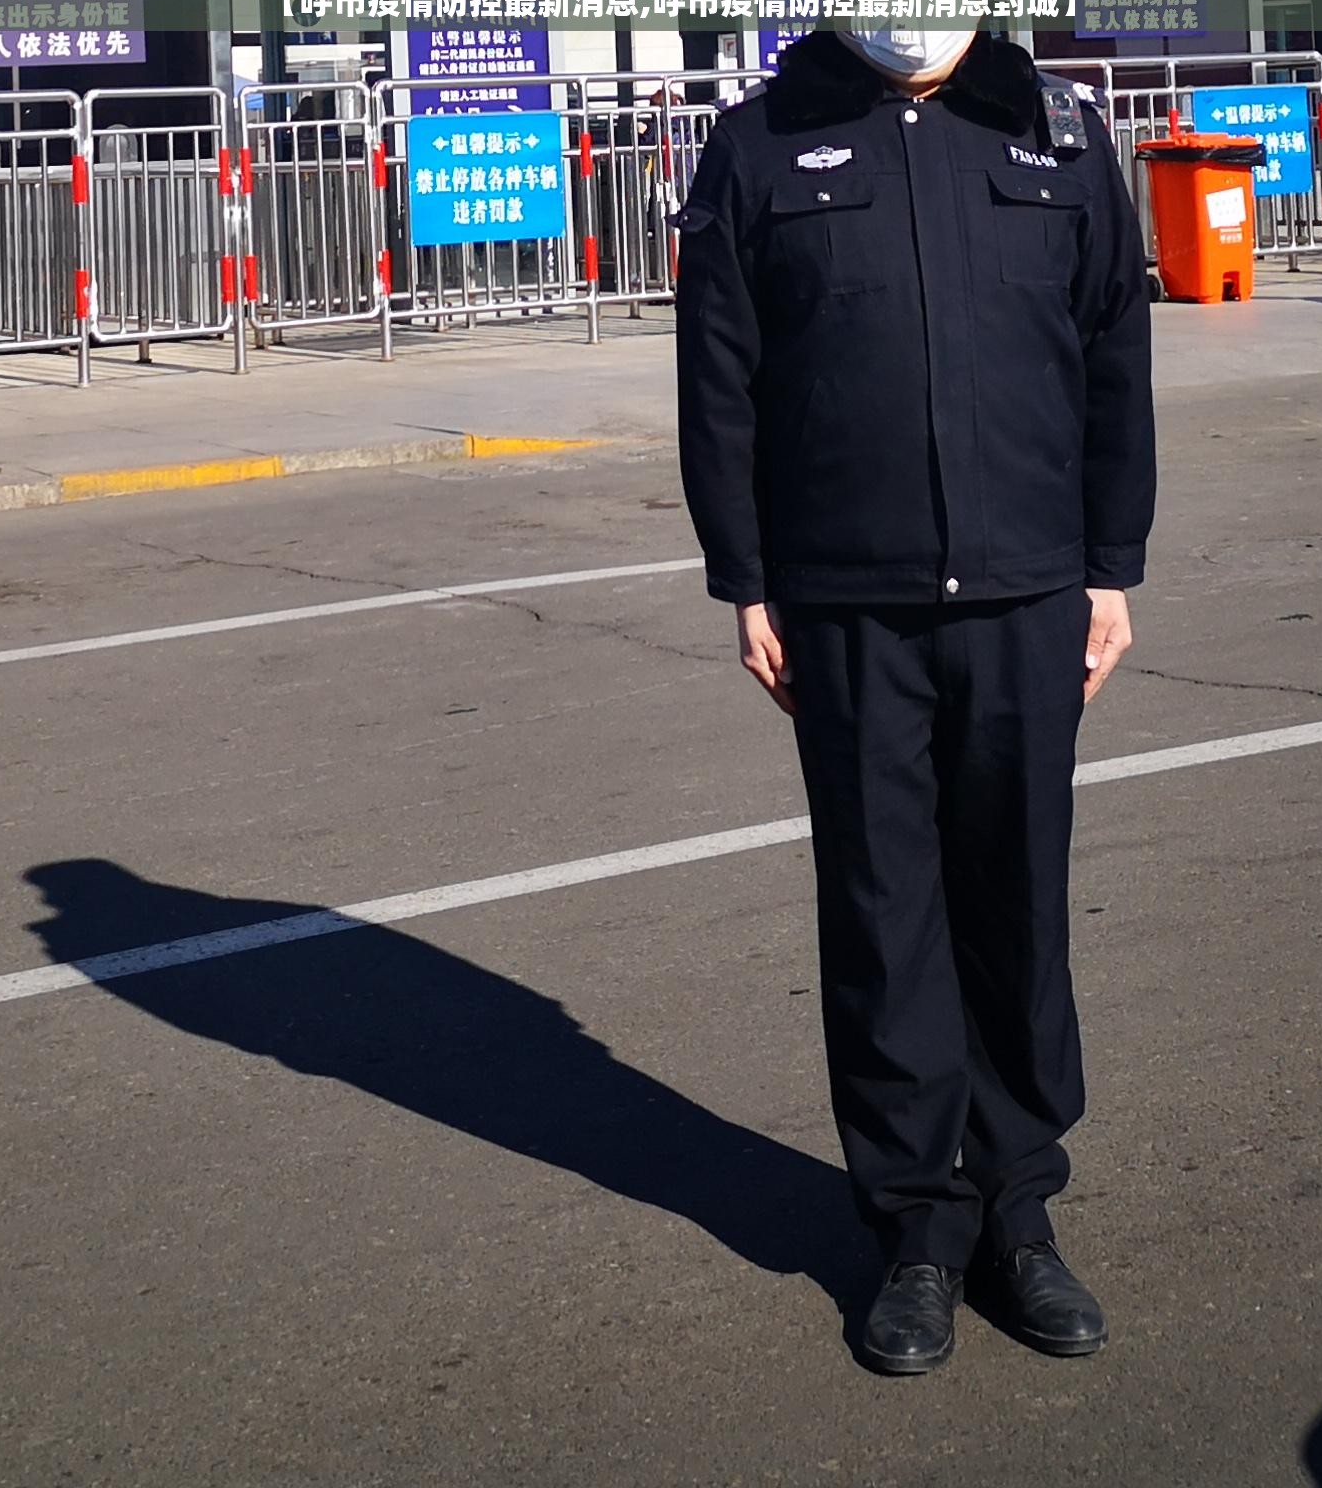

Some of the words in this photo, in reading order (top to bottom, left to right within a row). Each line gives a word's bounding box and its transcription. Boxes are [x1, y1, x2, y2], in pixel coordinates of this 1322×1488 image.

[1084, 8, 1199, 32] 军人依法优先
[1226, 104, 1277, 125] 温馨提示
[451, 132, 522, 155] 温馨提示
[415, 164, 558, 195] 禁止停放各种车辆
[453, 197, 524, 225] 违者罚款
